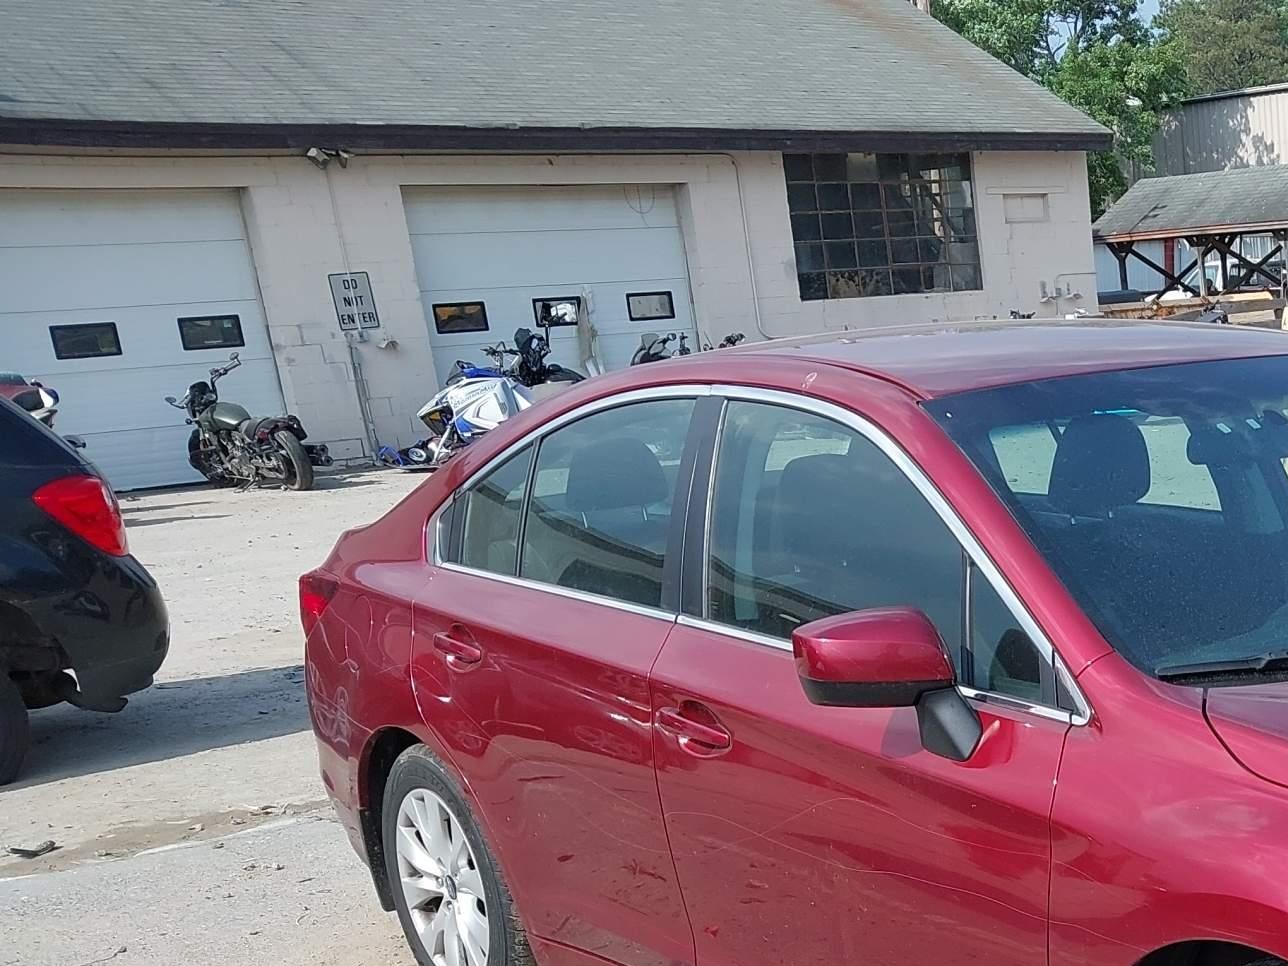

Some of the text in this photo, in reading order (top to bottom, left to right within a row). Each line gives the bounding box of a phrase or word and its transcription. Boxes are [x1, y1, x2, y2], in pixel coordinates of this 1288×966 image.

[342, 278, 358, 290] DO
[342, 295, 364, 307] NOT
[340, 312, 376, 325] ENTER
